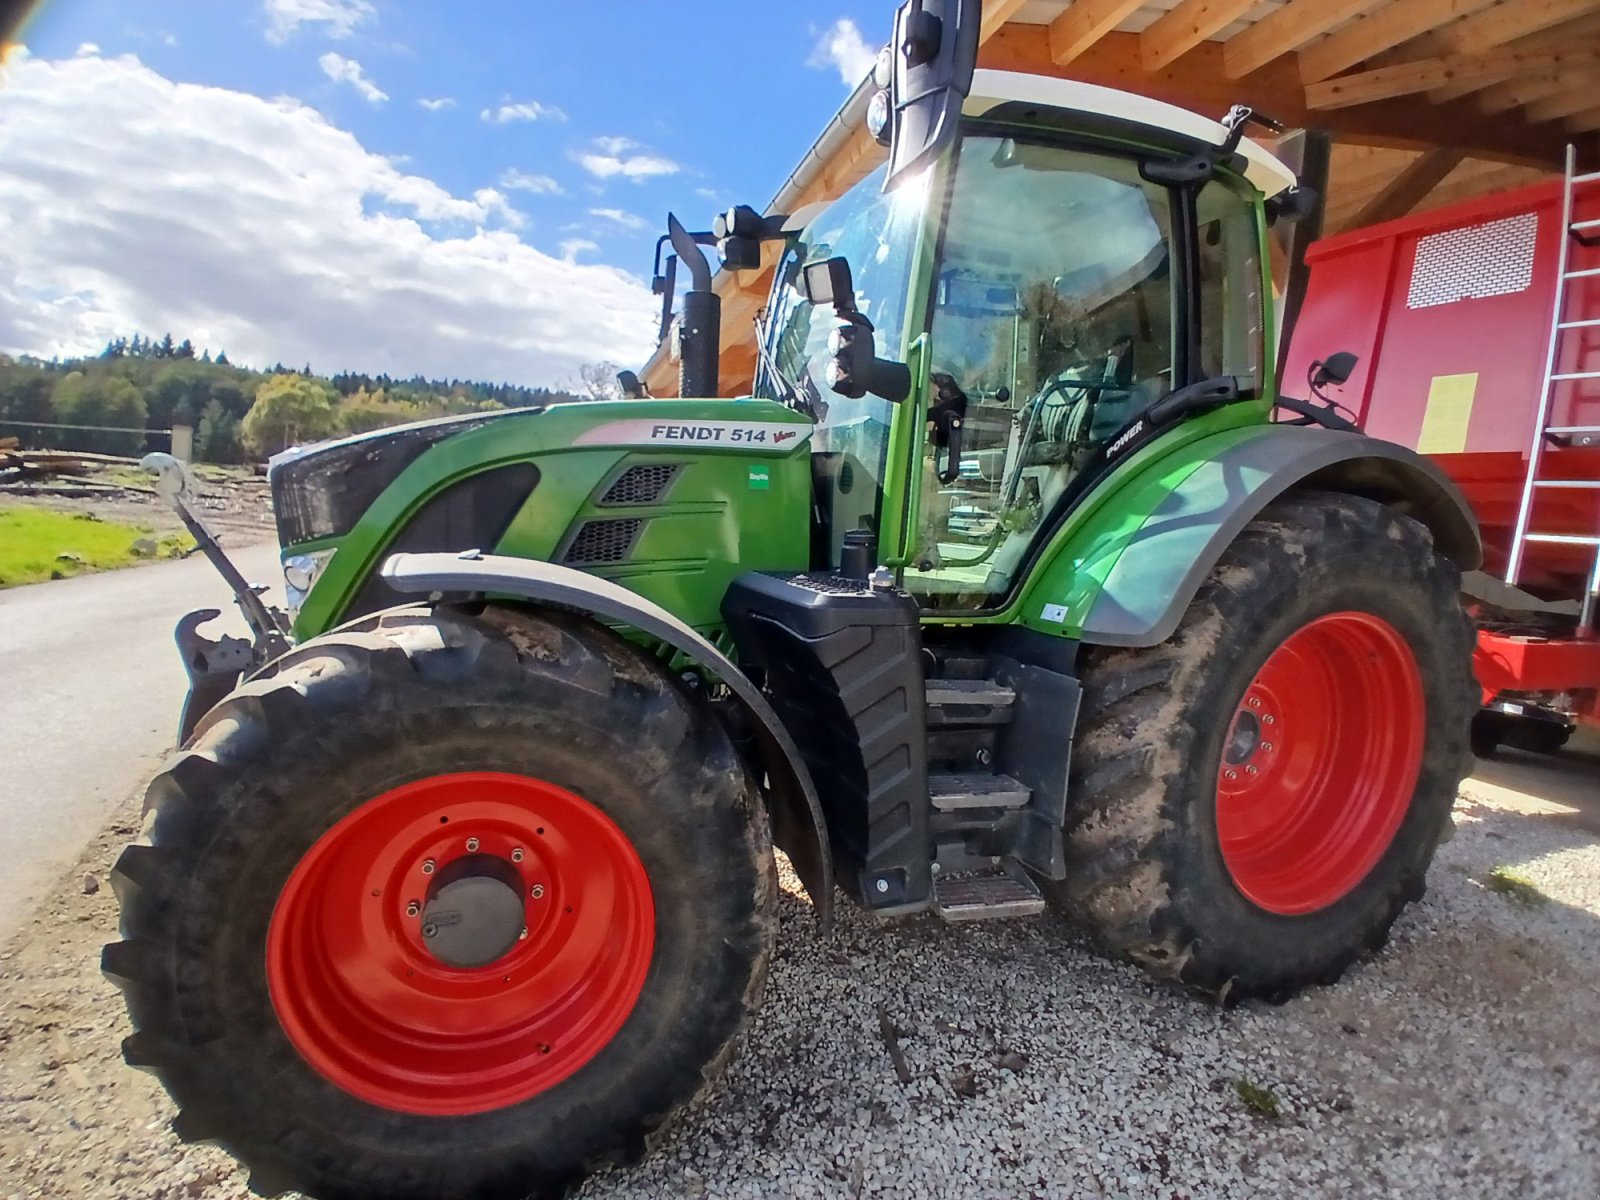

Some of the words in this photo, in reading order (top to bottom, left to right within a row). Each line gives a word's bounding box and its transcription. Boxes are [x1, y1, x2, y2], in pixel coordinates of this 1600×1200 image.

[652, 425, 725, 440] FENDT
[730, 429, 766, 442] 514
[1106, 420, 1143, 459] POWER
